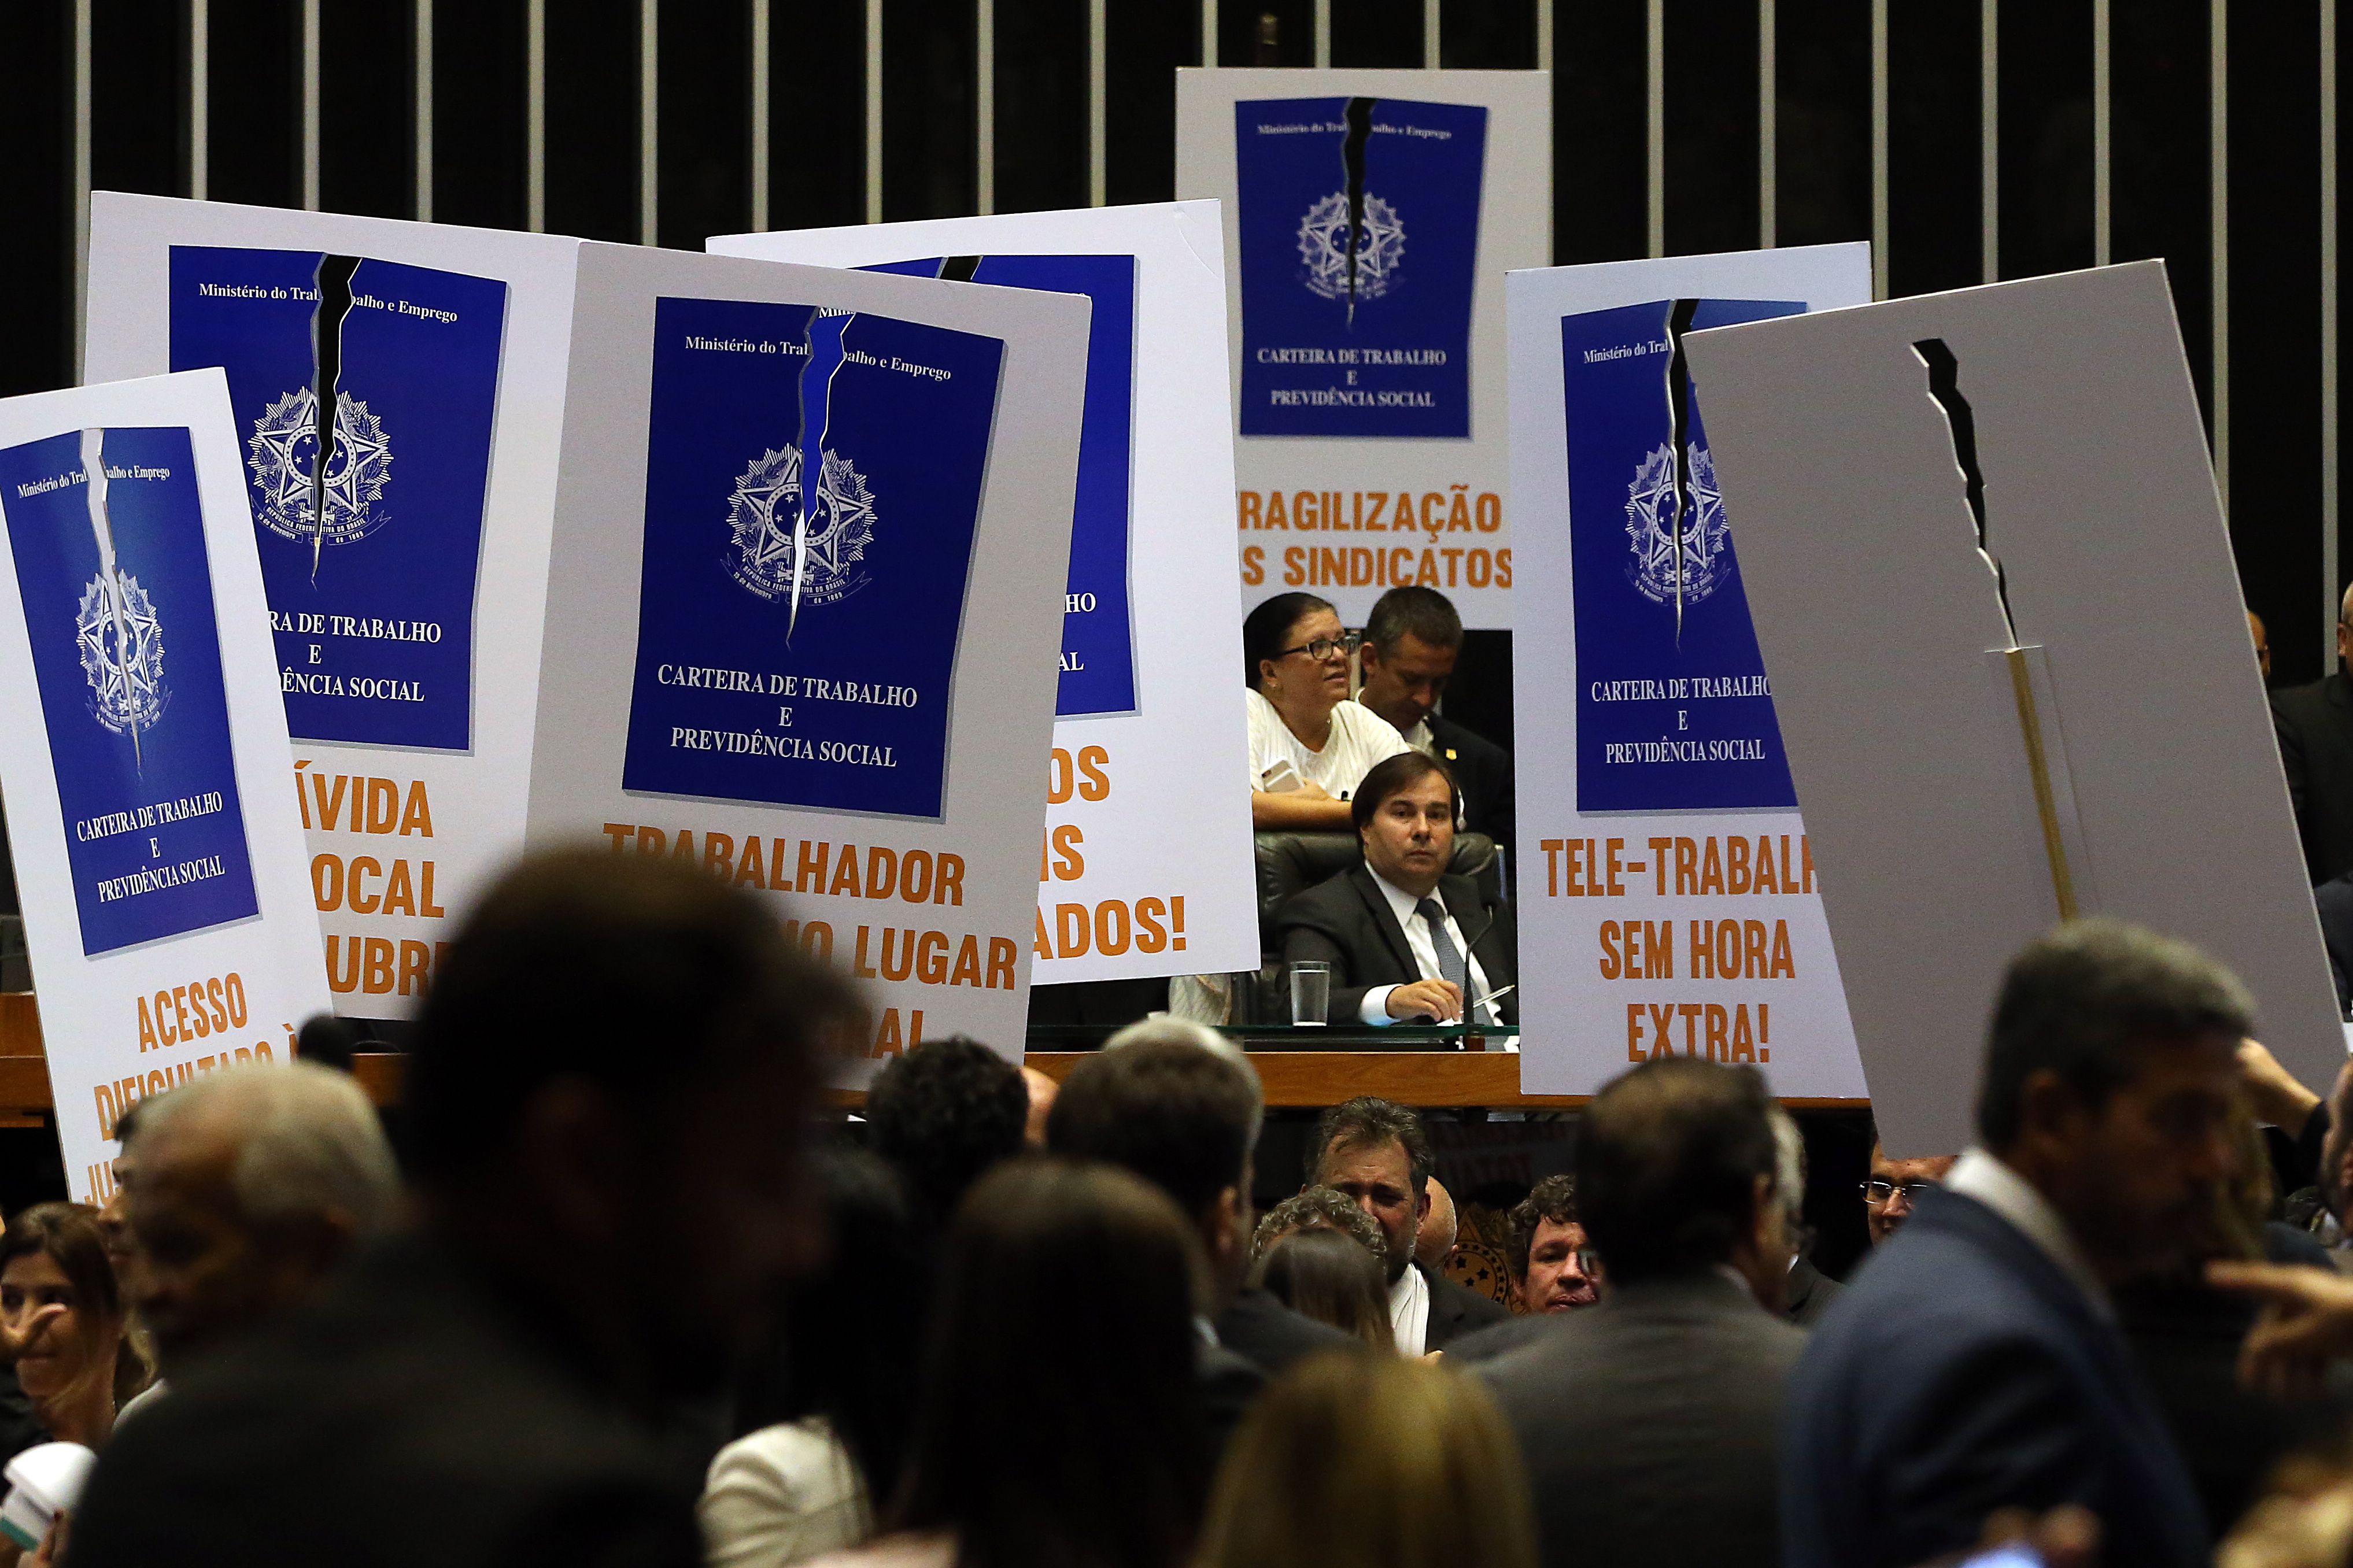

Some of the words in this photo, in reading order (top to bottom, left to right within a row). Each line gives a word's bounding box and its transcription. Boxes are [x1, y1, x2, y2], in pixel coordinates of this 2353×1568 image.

[200, 284, 267, 298] Ministério
[271, 287, 287, 299] do
[388, 302, 394, 310] e
[398, 301, 457, 323] Emprego
[686, 337, 755, 352] Ministério
[760, 341, 775, 353] do
[880, 359, 886, 367] e
[891, 357, 951, 380] Emprego
[1257, 349, 1335, 363] CARTEIRA
[1339, 349, 1359, 364] DE
[1363, 349, 1446, 364] TRABALHO
[1584, 345, 1632, 363] Ministério
[1634, 343, 1646, 356] do
[1272, 387, 1375, 406] PREVIDÊNCIA
[1378, 392, 1435, 406] SOCIAL
[1347, 370, 1357, 384] E
[17, 478, 58, 498] Ministério
[60, 475, 69, 487] do
[128, 469, 132, 478] e
[134, 465, 169, 481] Emprego
[1240, 485, 1501, 542] RAGILIZAÇÃO
[1285, 547, 1512, 589] SINDICATOS
[298, 613, 324, 633] DE
[330, 616, 441, 642] TRABALHO
[309, 645, 321, 664] E
[350, 678, 424, 701] SOCIAL
[658, 665, 764, 693] CARTEIRA
[769, 675, 797, 696] DE
[803, 678, 917, 707] TRABALHO
[1592, 680, 1665, 701] CARTEIRA
[1669, 679, 1688, 698] DE
[779, 707, 792, 726] E
[1678, 711, 1687, 730] E
[671, 728, 814, 759] PREVIDÊNCIA
[819, 742, 896, 767] SOCIAL
[1606, 736, 1706, 763] PREVIDÊNCIA
[1710, 739, 1765, 760] SOCIAL
[77, 810, 138, 842] CARTEIRA
[137, 806, 156, 829] DE
[157, 792, 222, 823] TRABALHO
[150, 838, 160, 858] E
[98, 866, 181, 903] PREVIDÊNCIA
[180, 856, 224, 883] SOCIAL
[311, 854, 444, 918] OCAL
[1034, 896, 1186, 959] ADOS!
[854, 926, 1017, 990] LUGAR
[1601, 920, 1672, 979] SEM
[1691, 919, 1795, 979] HORA
[138, 972, 248, 1053] ACESSO
[1628, 1004, 1769, 1064] EXTRA!
